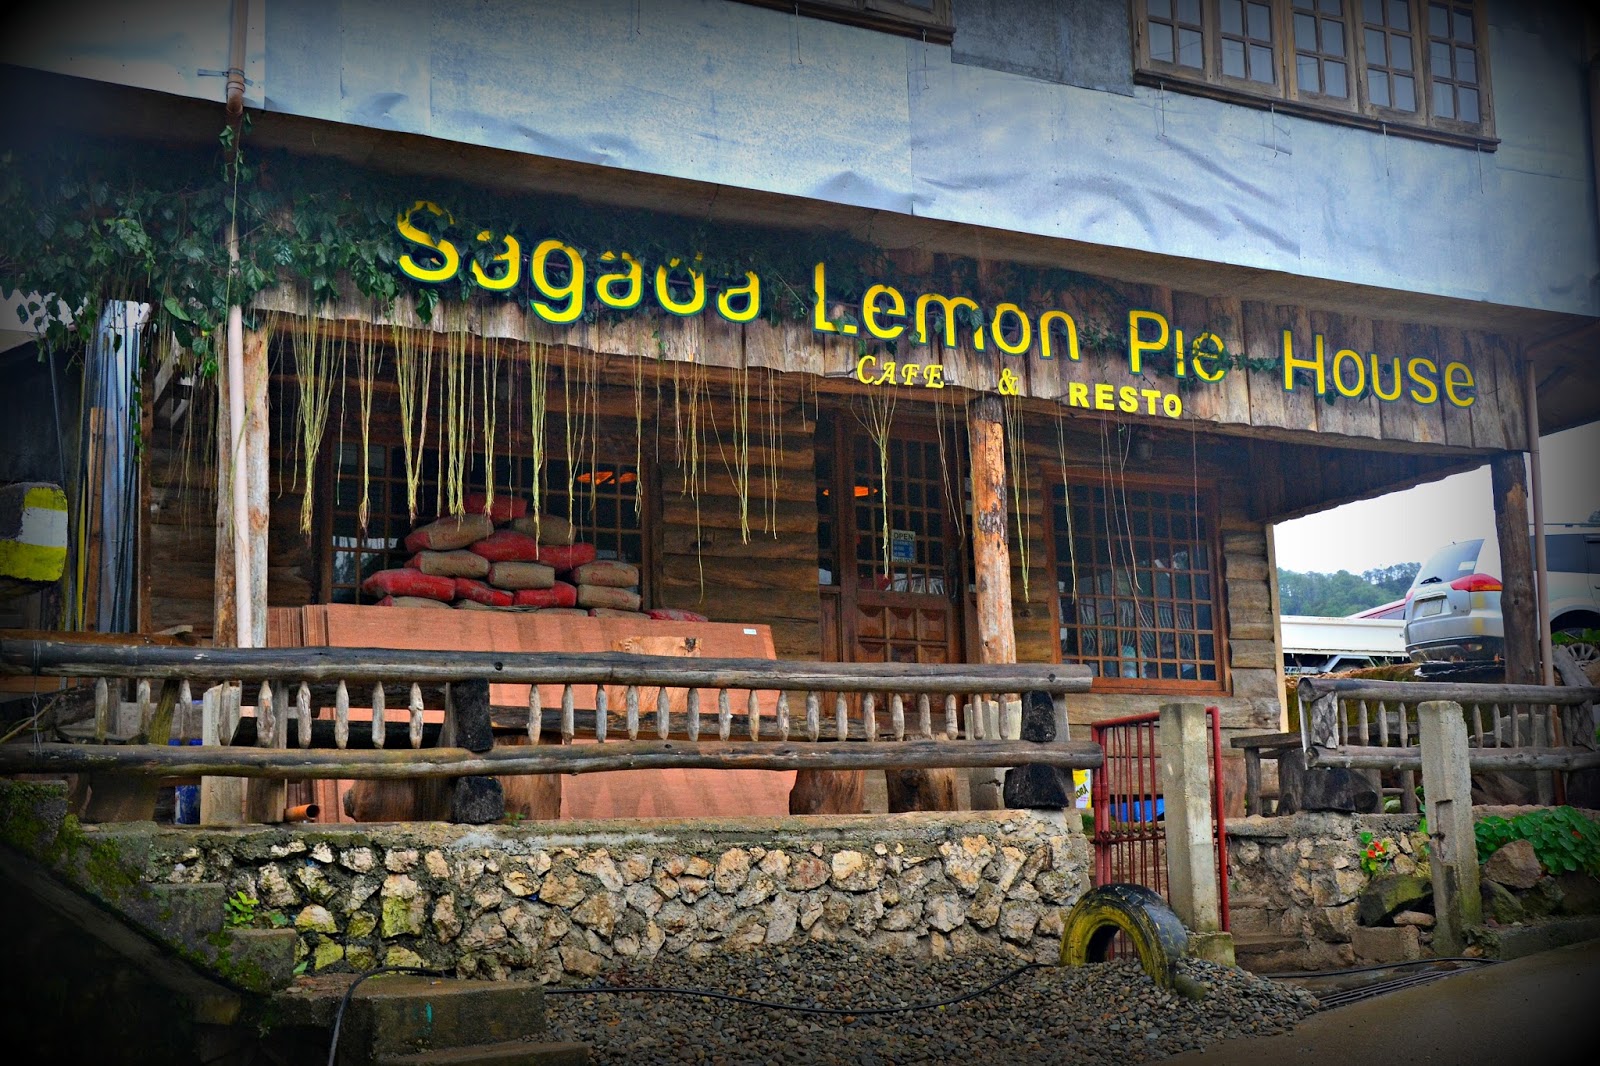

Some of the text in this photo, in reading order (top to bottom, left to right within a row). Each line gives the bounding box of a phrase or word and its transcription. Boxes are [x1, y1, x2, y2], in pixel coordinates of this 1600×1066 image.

[813, 262, 1081, 361] Lemon
[1282, 329, 1477, 408] House
[856, 355, 1183, 418] CAFE & RESTO
[893, 532, 914, 540] OPEN
